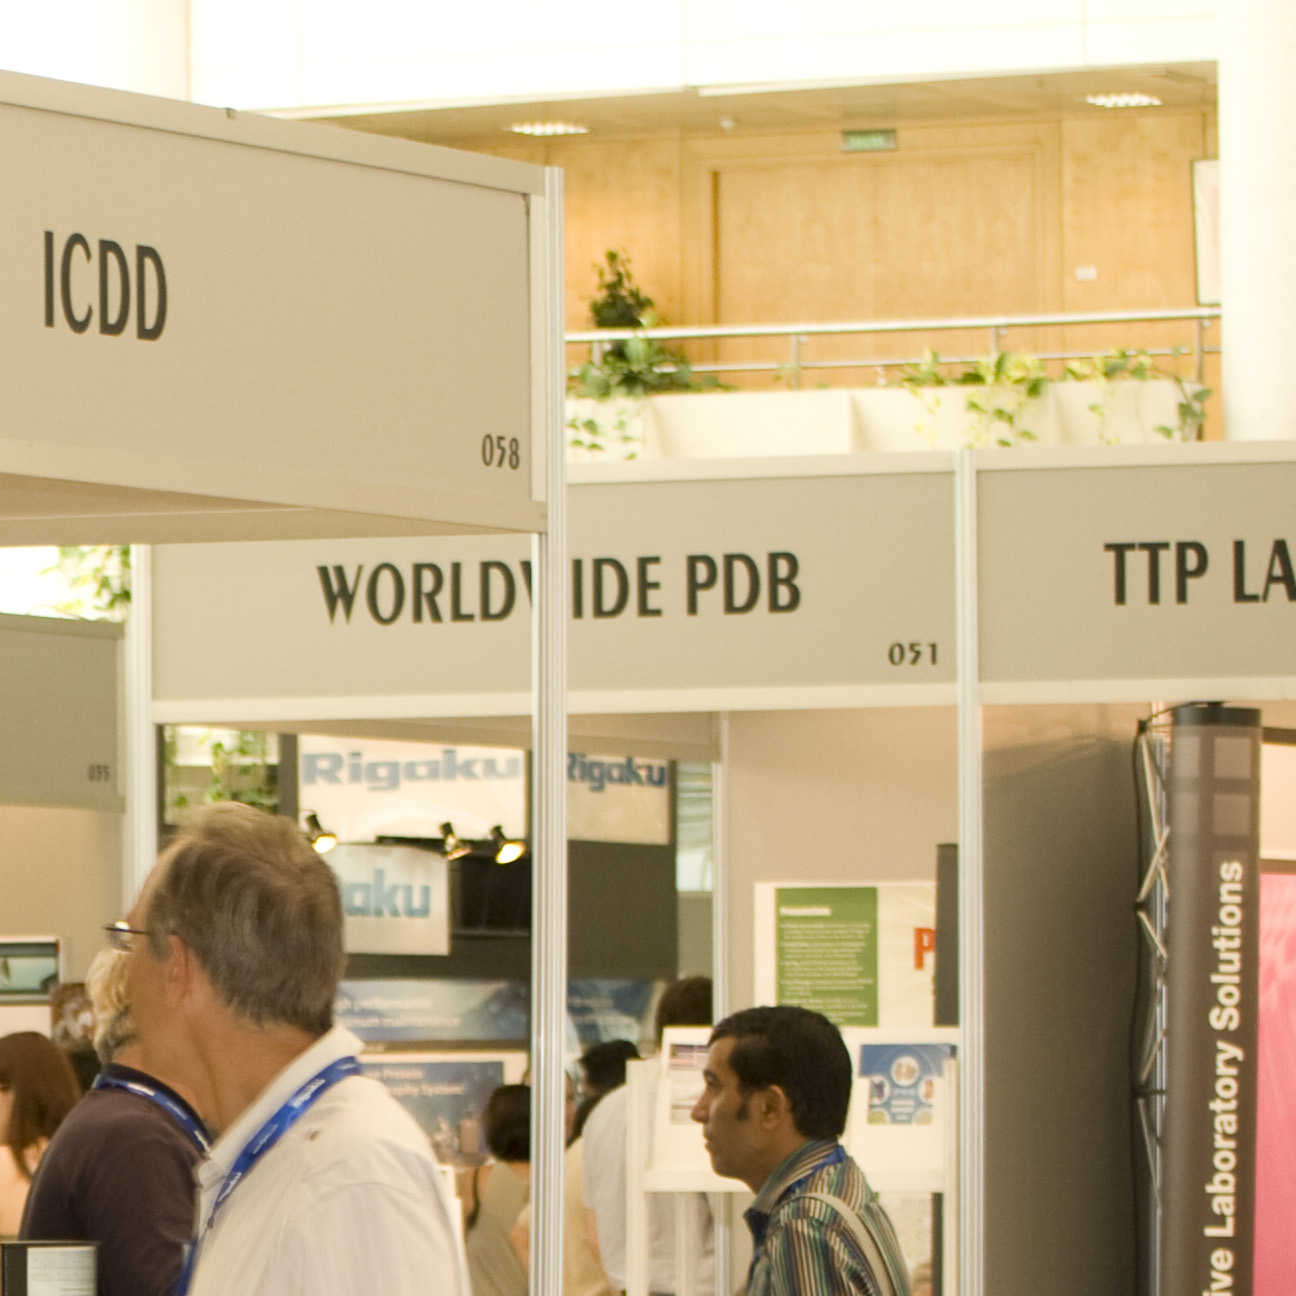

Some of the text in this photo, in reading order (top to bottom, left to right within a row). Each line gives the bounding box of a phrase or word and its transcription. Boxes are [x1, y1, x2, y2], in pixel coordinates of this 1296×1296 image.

[43, 229, 169, 342] ICDD
[481, 433, 521, 471] 058
[316, 551, 803, 627] WORLDIDE PDB
[1103, 538, 1296, 606] TTP LA
[888, 641, 939, 667] 051
[301, 749, 522, 792] Rigaku
[1208, 860, 1244, 1032] Solutions
[1203, 1039, 1244, 1238] Laboratory
